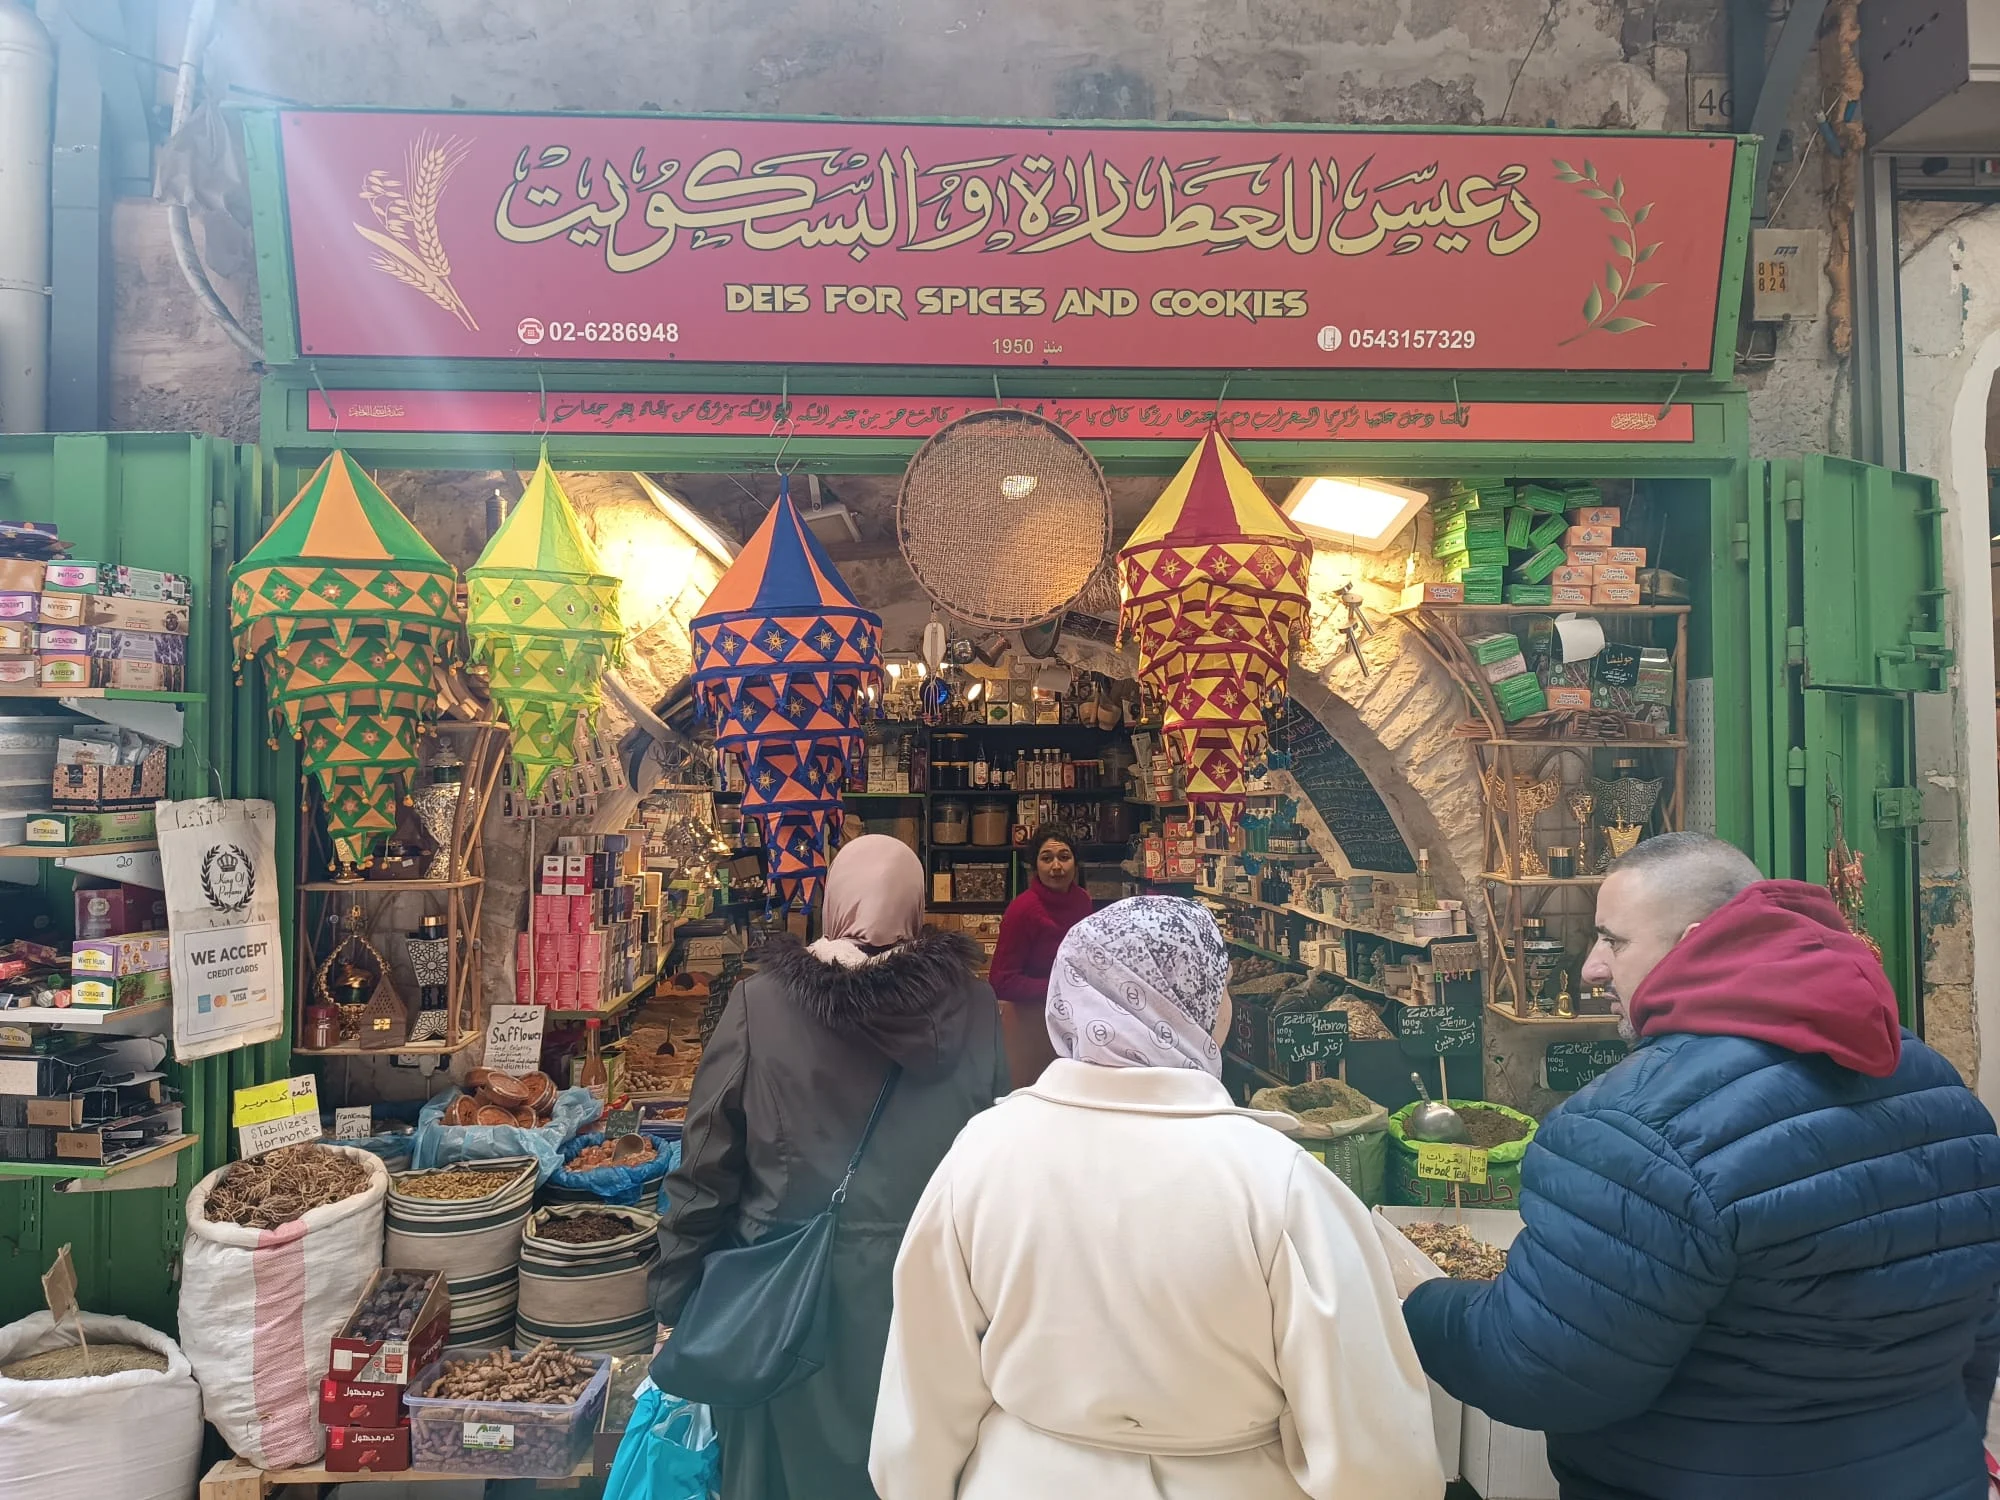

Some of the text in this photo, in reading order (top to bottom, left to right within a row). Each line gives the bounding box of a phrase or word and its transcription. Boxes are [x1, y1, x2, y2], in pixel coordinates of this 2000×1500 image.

[495, 145, 1541, 273] دعيس للعطارة والبسكويت
[1758, 261, 1786, 276] 815
[1758, 277, 1786, 292] 824
[724, 283, 1309, 325] DEIS FOR SPICES AND COOKIES
[548, 322, 680, 343] 02-6286948
[1349, 329, 1476, 349] 0543157329
[992, 338, 1063, 354] منذ 1950
[57, 572, 85, 581] OPIUM
[47, 636, 78, 645] LAVENDER
[50, 668, 75, 676] AMBER
[116, 855, 133, 868] 20
[191, 942, 268, 966] WE ACCEPT
[207, 963, 259, 980] CREDIT CARDS
[232, 993, 247, 1002] VISA
[1283, 1013, 1318, 1025] Zatar
[1406, 1006, 1455, 1018] Zatar
[1312, 1019, 1349, 1035] Hebron
[1440, 1015, 1467, 1028] Jenin
[1434, 1029, 1476, 1052] زعتر جنين
[1290, 1041, 1319, 1062] الخليل
[292, 1087, 312, 1098] each
[343, 1387, 385, 1398] تمر مجهول
[351, 1433, 395, 1444] تمر مجهول
